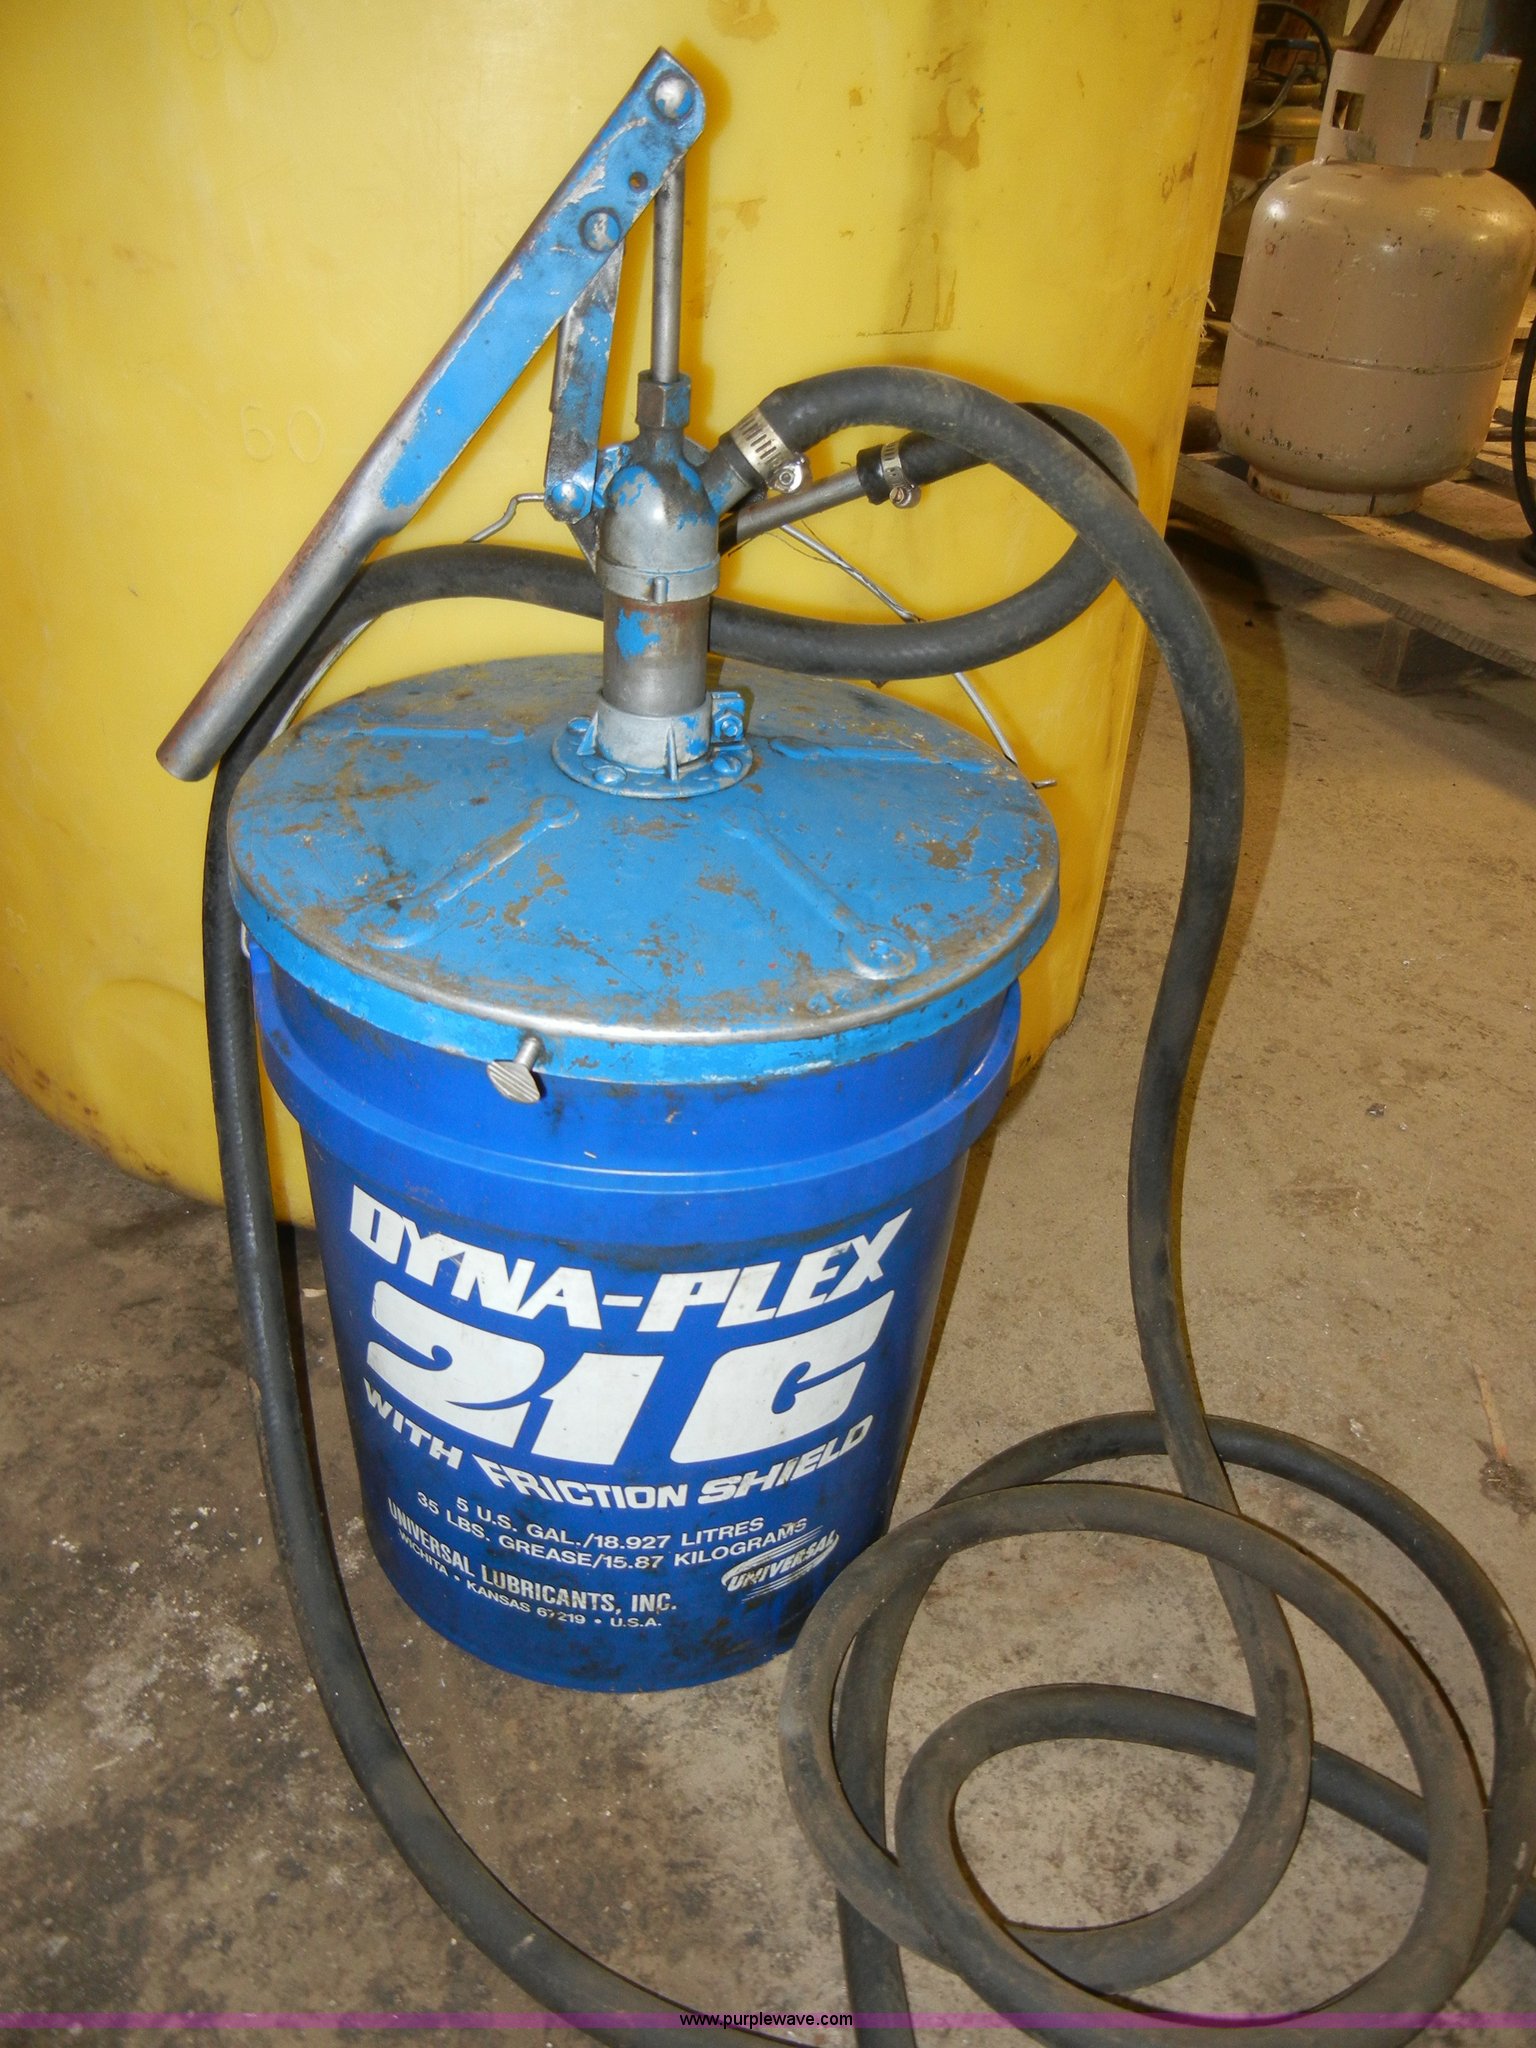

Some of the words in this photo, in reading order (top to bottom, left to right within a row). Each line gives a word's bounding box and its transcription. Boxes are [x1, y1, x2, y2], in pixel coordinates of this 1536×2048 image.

[349, 1184, 912, 1333] DYNA-PLEX
[363, 1378, 462, 1470] WITH
[472, 1453, 688, 1509] FRICTION
[697, 1414, 873, 1504] SHIELD
[387, 1496, 476, 1578] UNIVERSAL
[481, 1563, 622, 1615] LUBRICANTS,
[631, 1592, 677, 1613] INC.
[417, 1491, 440, 1515] 35
[446, 1509, 491, 1542] LBS.
[498, 1534, 665, 1570] GREASE/15.87
[673, 1517, 808, 1567] KILOGRAMS
[456, 1496, 470, 1513] 5
[476, 1505, 518, 1532] U.S.
[526, 1522, 671, 1550] GAL./18.927
[681, 1517, 764, 1547] LITRES
[727, 1529, 836, 1592] UNIVERSAL
[398, 1527, 448, 1577] WICHITA
[466, 1579, 531, 1613] KANSAS
[536, 1606, 586, 1625] 67219
[610, 1616, 662, 1627] U.S.A.
